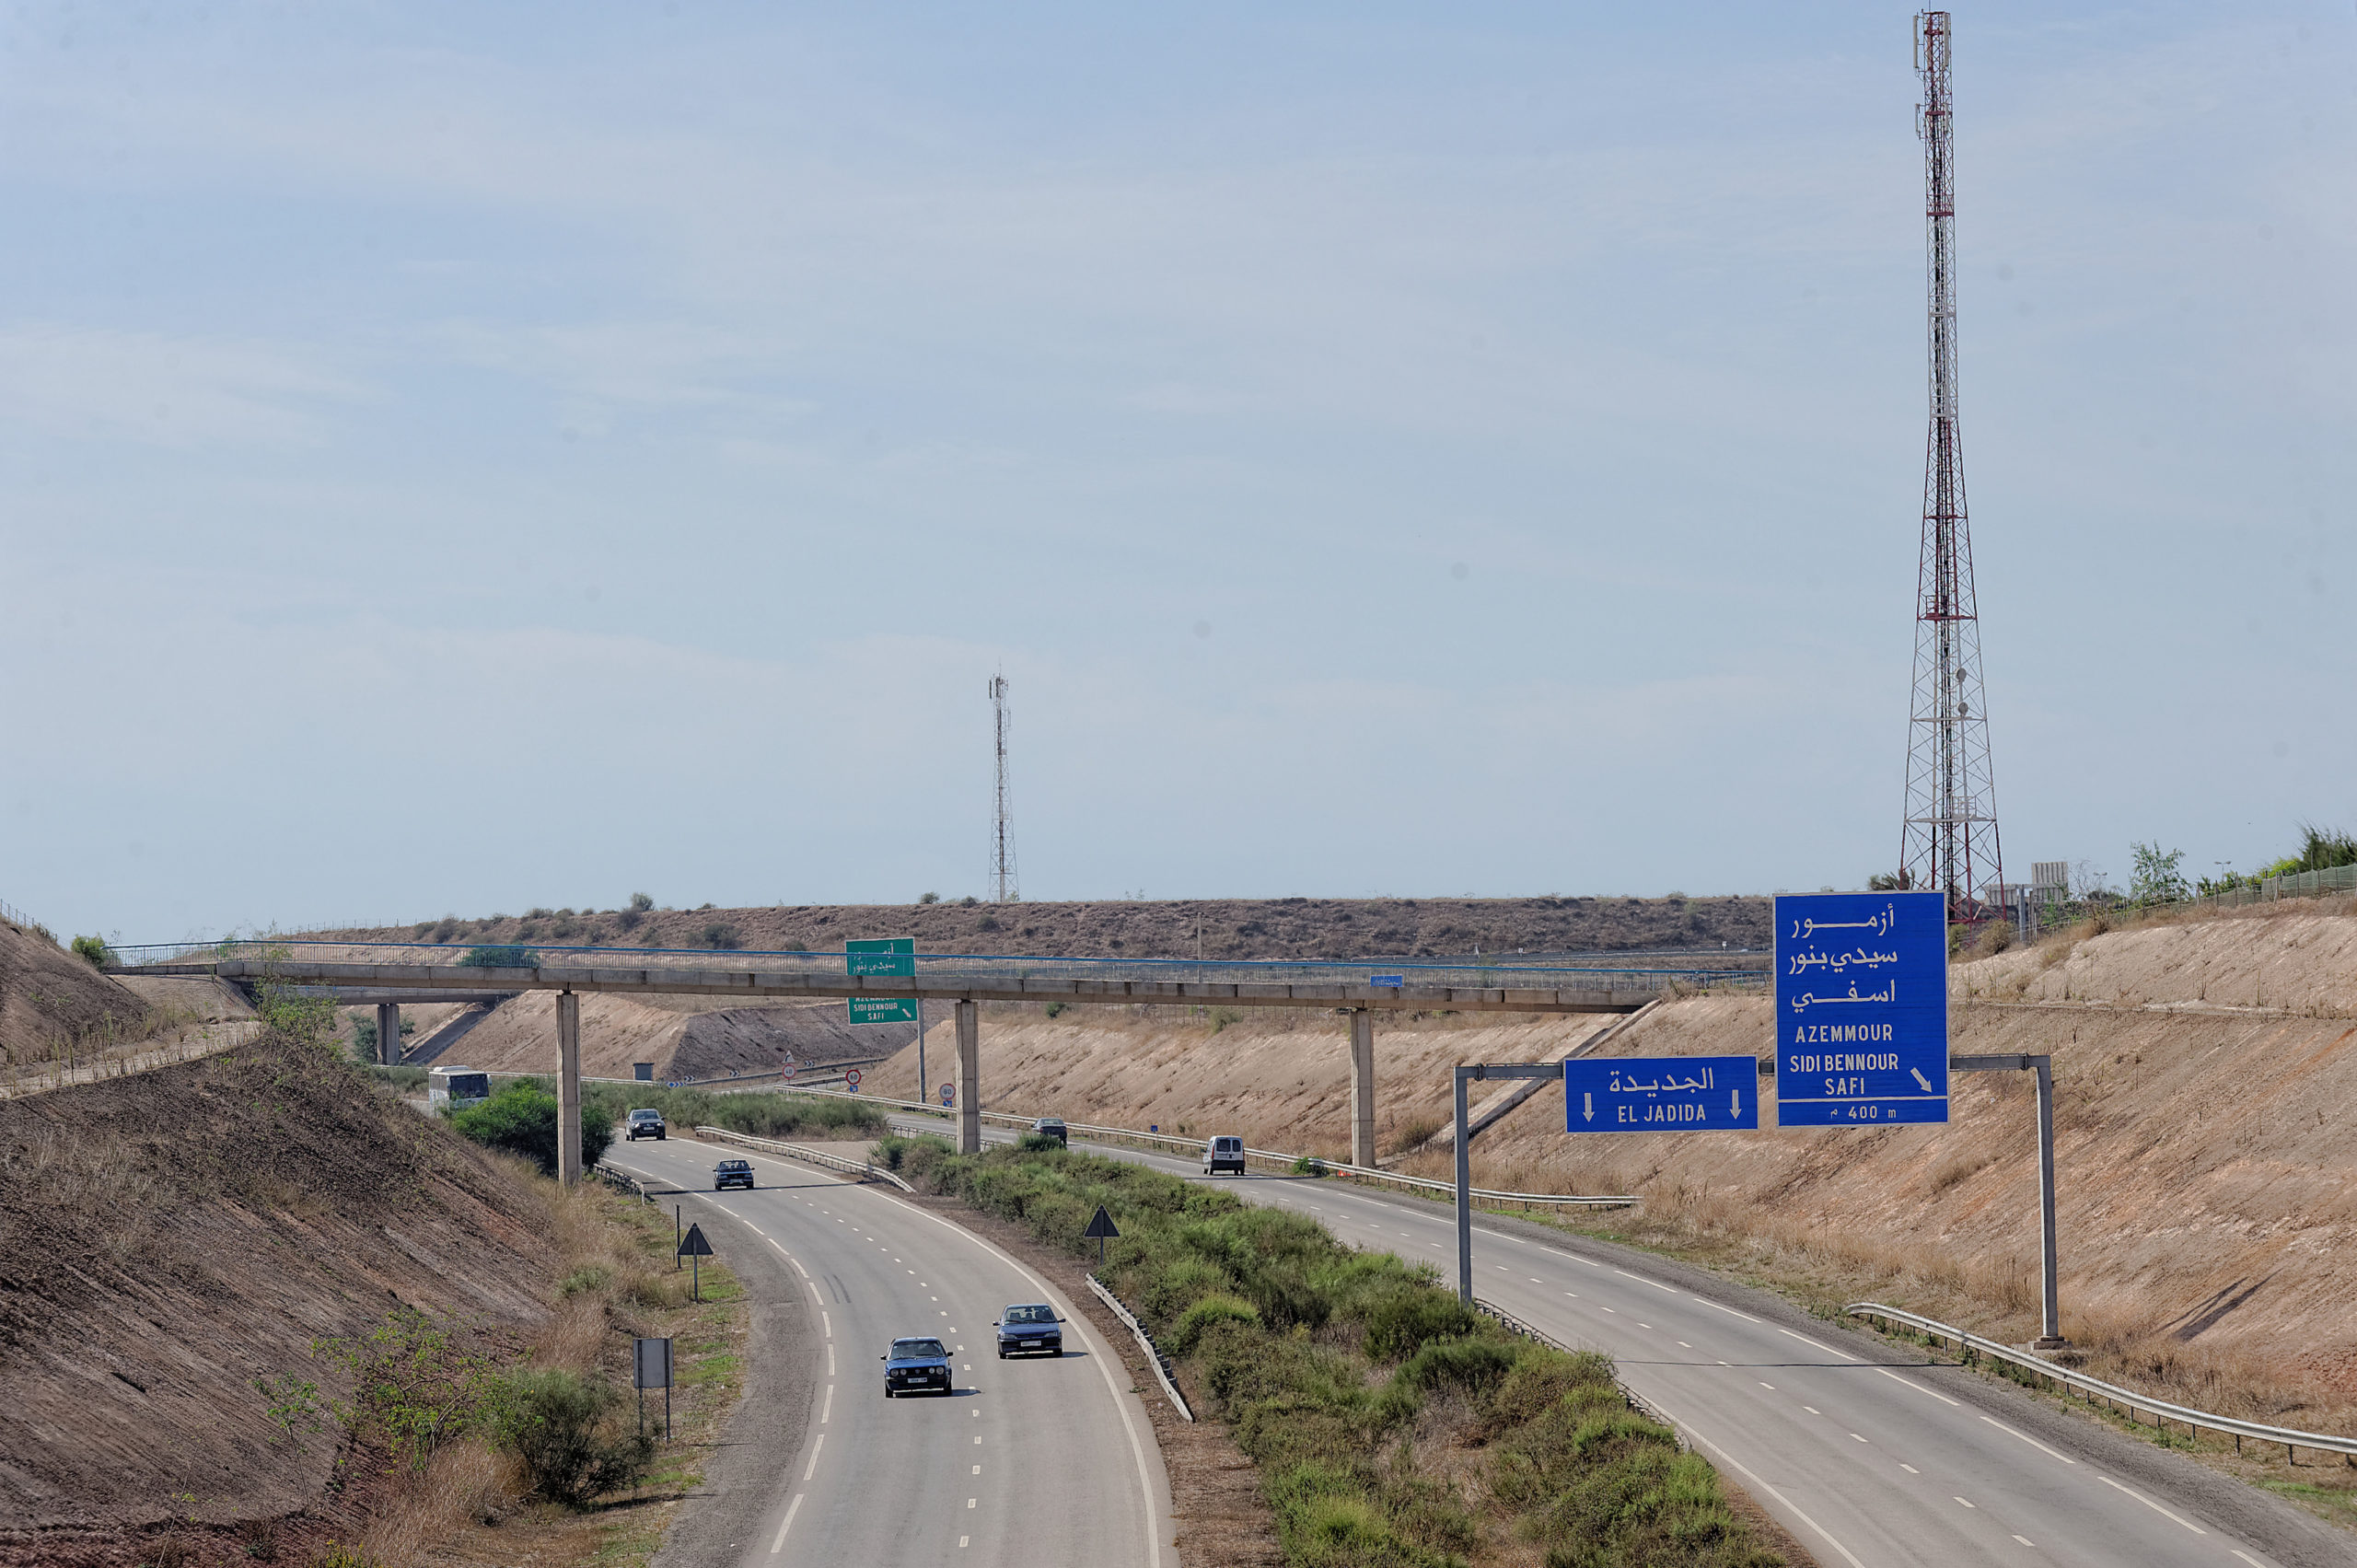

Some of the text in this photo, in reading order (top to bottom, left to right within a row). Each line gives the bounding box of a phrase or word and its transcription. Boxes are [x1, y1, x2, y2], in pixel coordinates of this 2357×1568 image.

[1792, 902, 1894, 938] أزمور
[1789, 945, 1898, 974] سيدي بنور
[1791, 979, 1896, 1013] اسفي
[853, 1003, 899, 1012] SIDI BENNOUR
[1795, 1024, 1893, 1043] AZEMMOUR
[1790, 1052, 1898, 1072] SIDI BENNOUR
[1609, 1067, 1714, 1098] الجديدة
[1825, 1077, 1864, 1096] SAFI
[1618, 1104, 1706, 1123] EL JADIDA
[1848, 1105, 1878, 1120] 400
[1887, 1109, 1897, 1119] m
